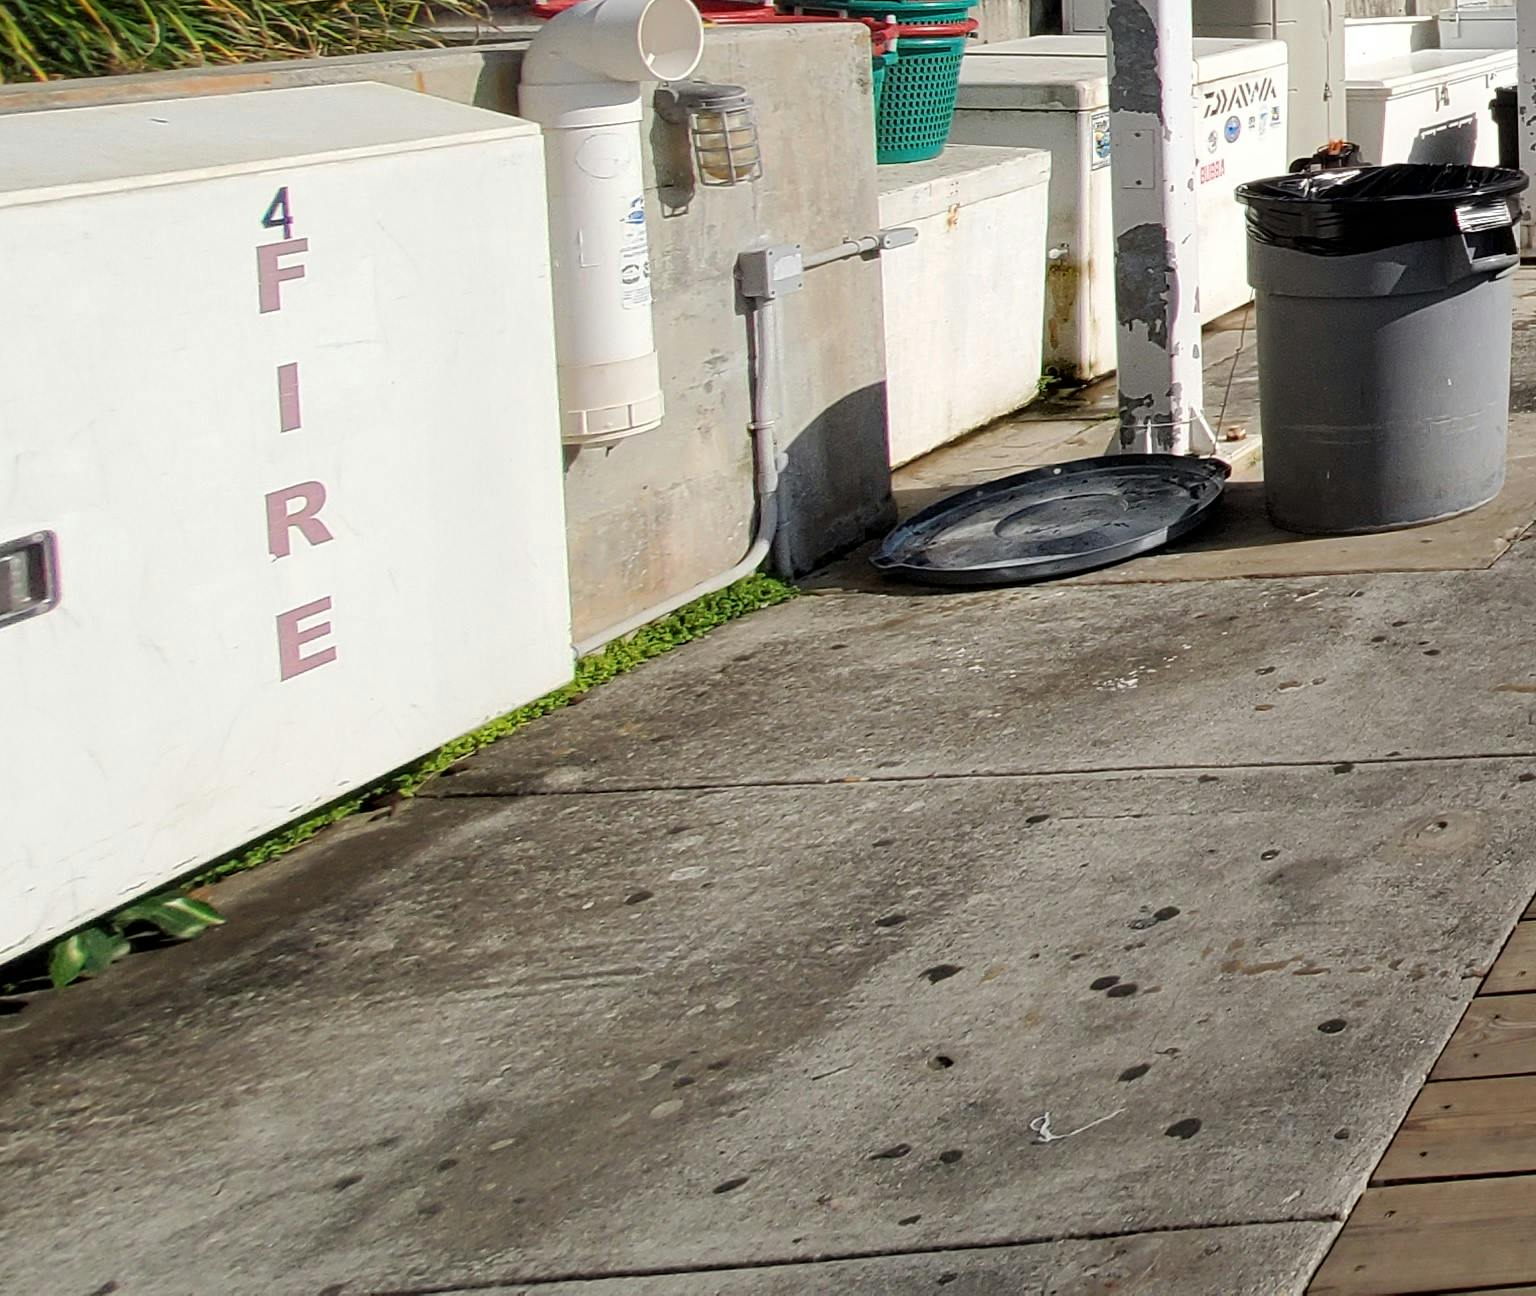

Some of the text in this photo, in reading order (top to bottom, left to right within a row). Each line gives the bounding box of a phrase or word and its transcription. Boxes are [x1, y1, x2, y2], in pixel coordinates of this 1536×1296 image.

[1203, 77, 1277, 119] DAIWA
[1199, 159, 1226, 185] BUBBA
[261, 186, 293, 239] 4
[256, 238, 339, 682] FIRE
